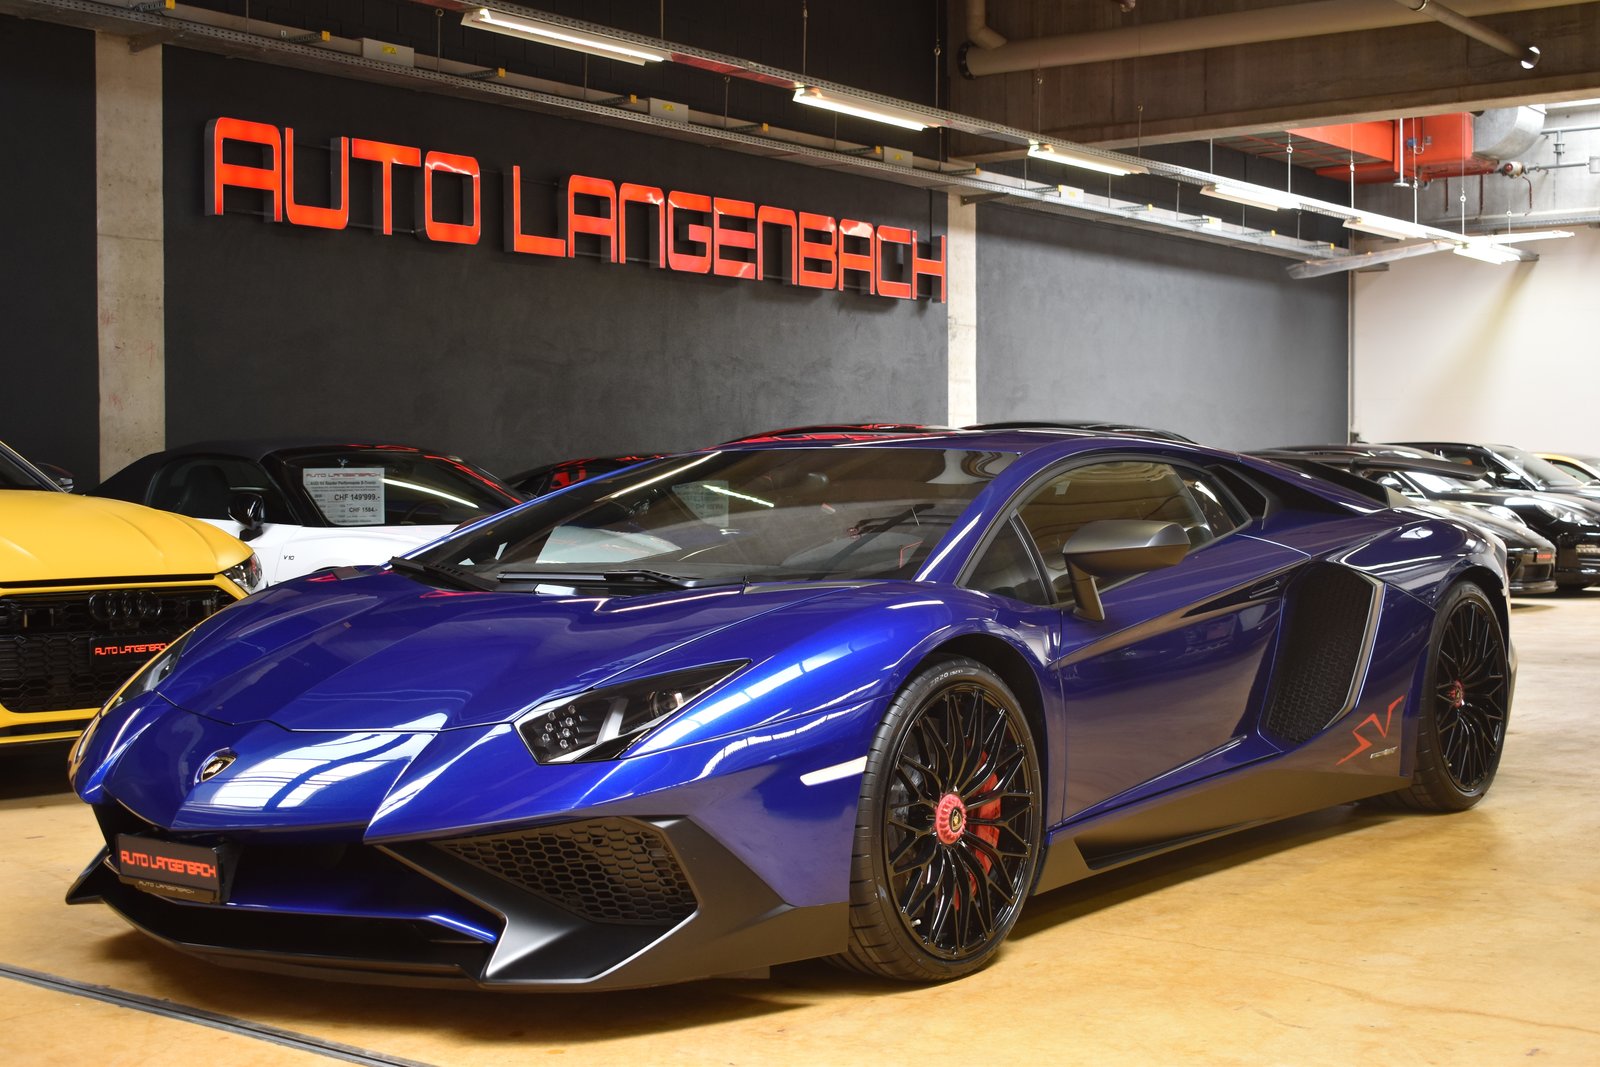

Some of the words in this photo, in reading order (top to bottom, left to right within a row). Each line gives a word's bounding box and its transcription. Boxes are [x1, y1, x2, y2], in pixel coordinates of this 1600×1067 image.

[208, 116, 481, 245] AUTO
[510, 165, 947, 304] LANGENBACH
[334, 493, 349, 501] CHF
[94, 646, 118, 656] AUTO
[1335, 695, 1405, 766] SV
[120, 849, 149, 868] AUTO
[149, 855, 217, 878] LANGENBACH
